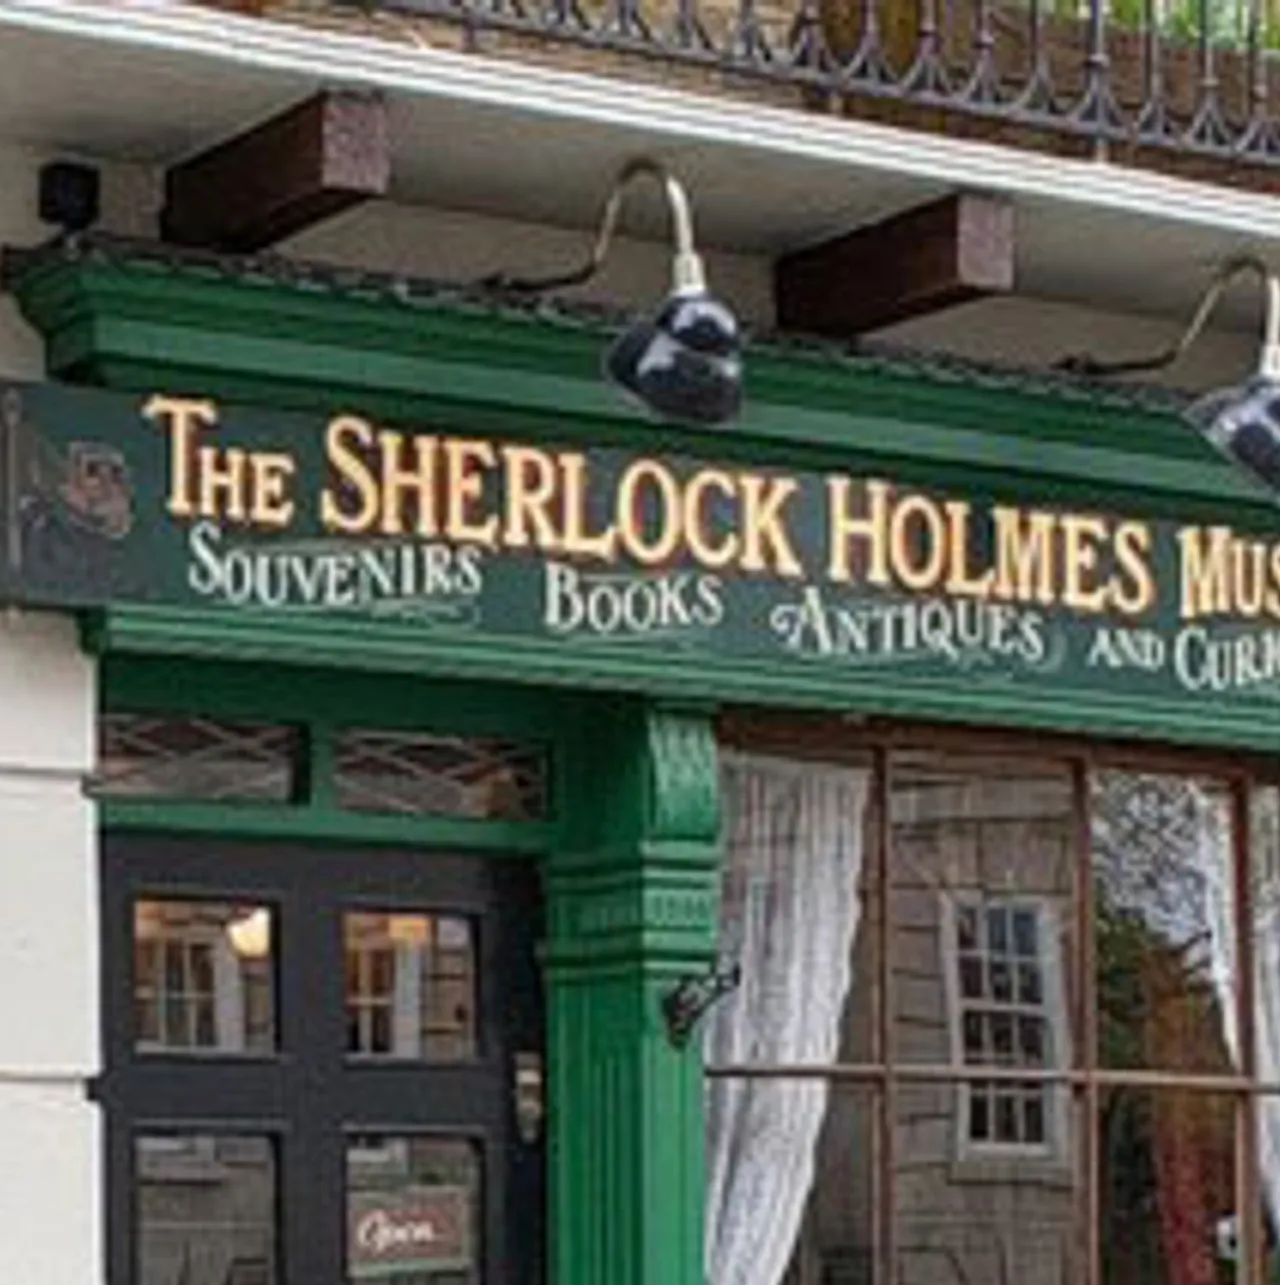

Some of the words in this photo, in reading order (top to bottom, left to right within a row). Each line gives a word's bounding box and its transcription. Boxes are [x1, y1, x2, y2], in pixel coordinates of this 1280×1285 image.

[142, 394, 297, 528] THE
[321, 413, 802, 577] SHERLOCK
[825, 472, 1154, 617] HOLMES
[188, 522, 484, 604] SOUVENIRS
[544, 562, 724, 633] BOOKS
[771, 584, 1046, 664] ANTIQUES
[1088, 631, 1165, 673] AND
